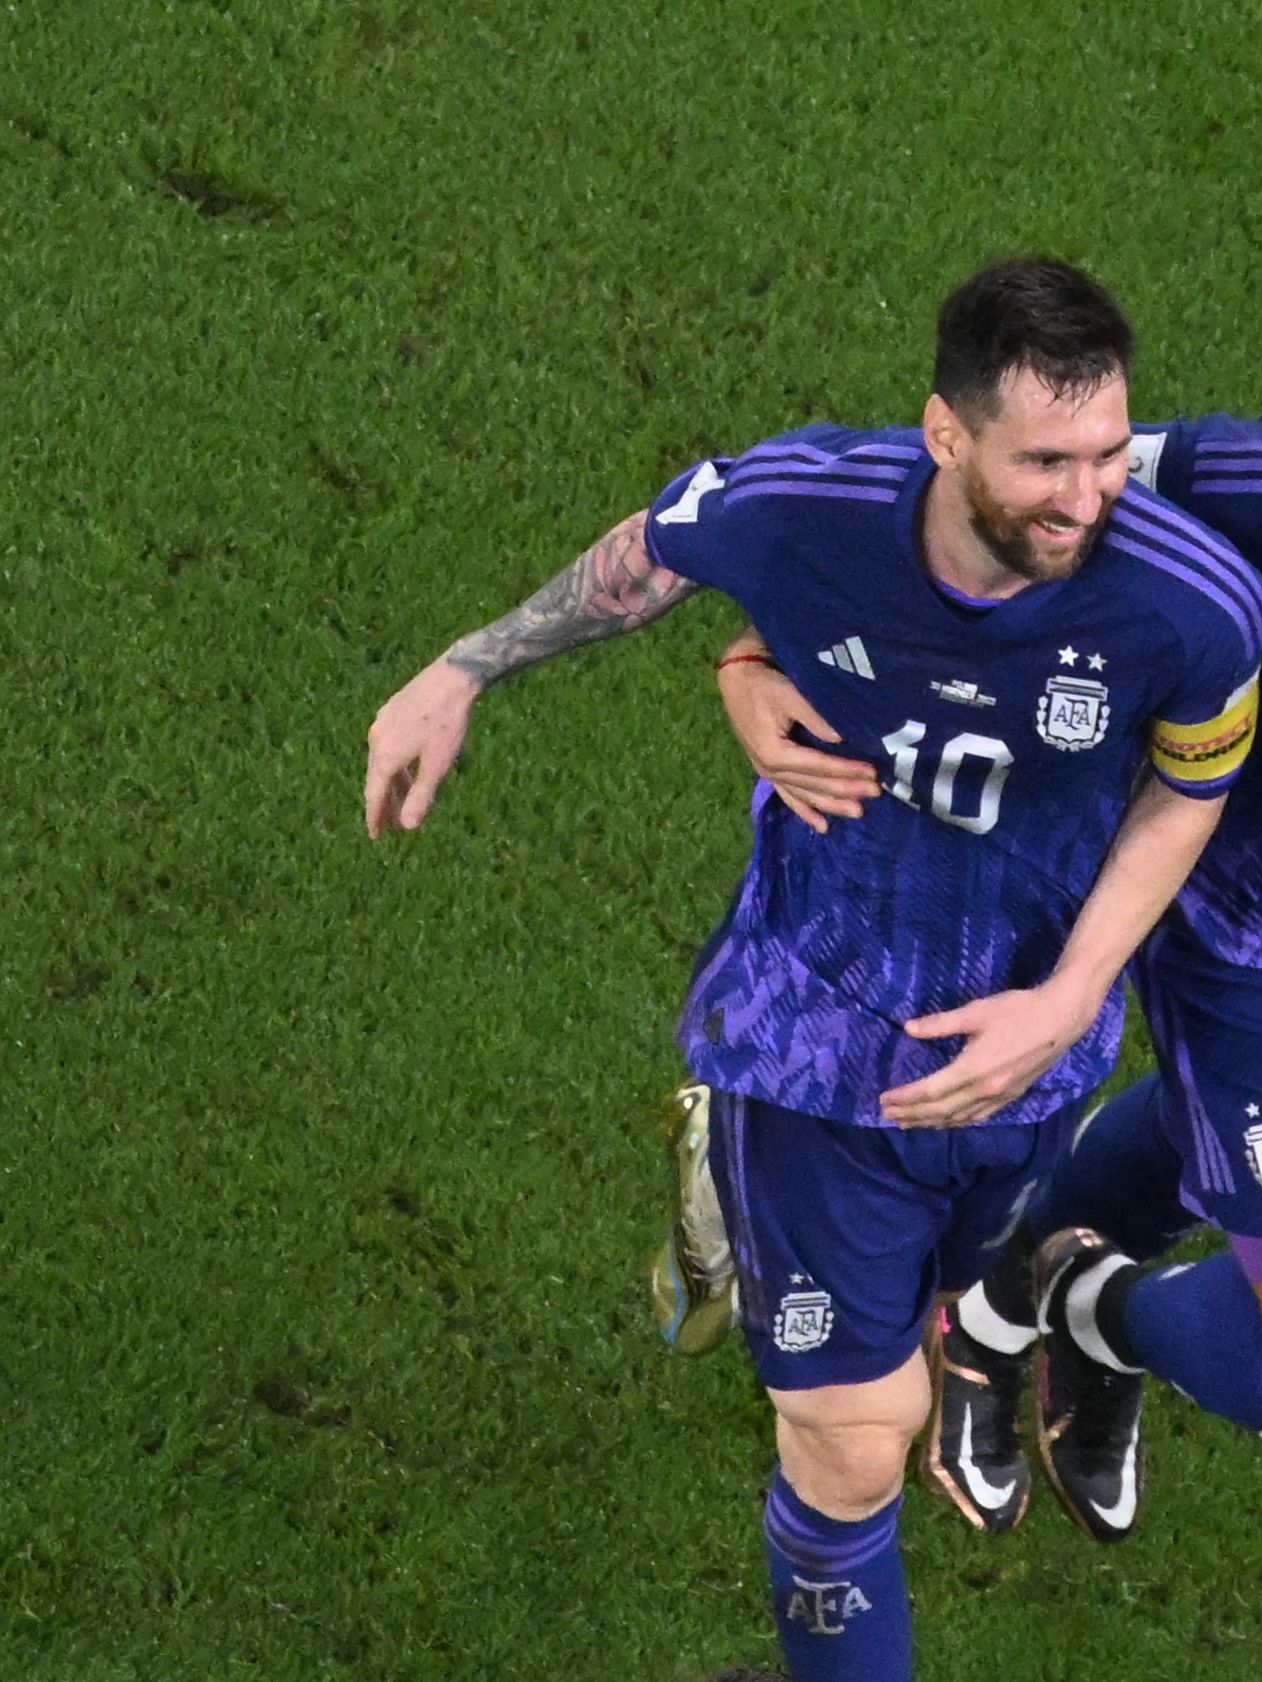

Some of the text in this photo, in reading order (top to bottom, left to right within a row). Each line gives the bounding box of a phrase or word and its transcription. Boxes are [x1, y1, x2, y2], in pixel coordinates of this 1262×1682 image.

[1053, 696, 1091, 731] AFA
[880, 719, 1015, 836] 10
[787, 1309, 819, 1337] AFA
[786, 1574, 872, 1635] AFA
